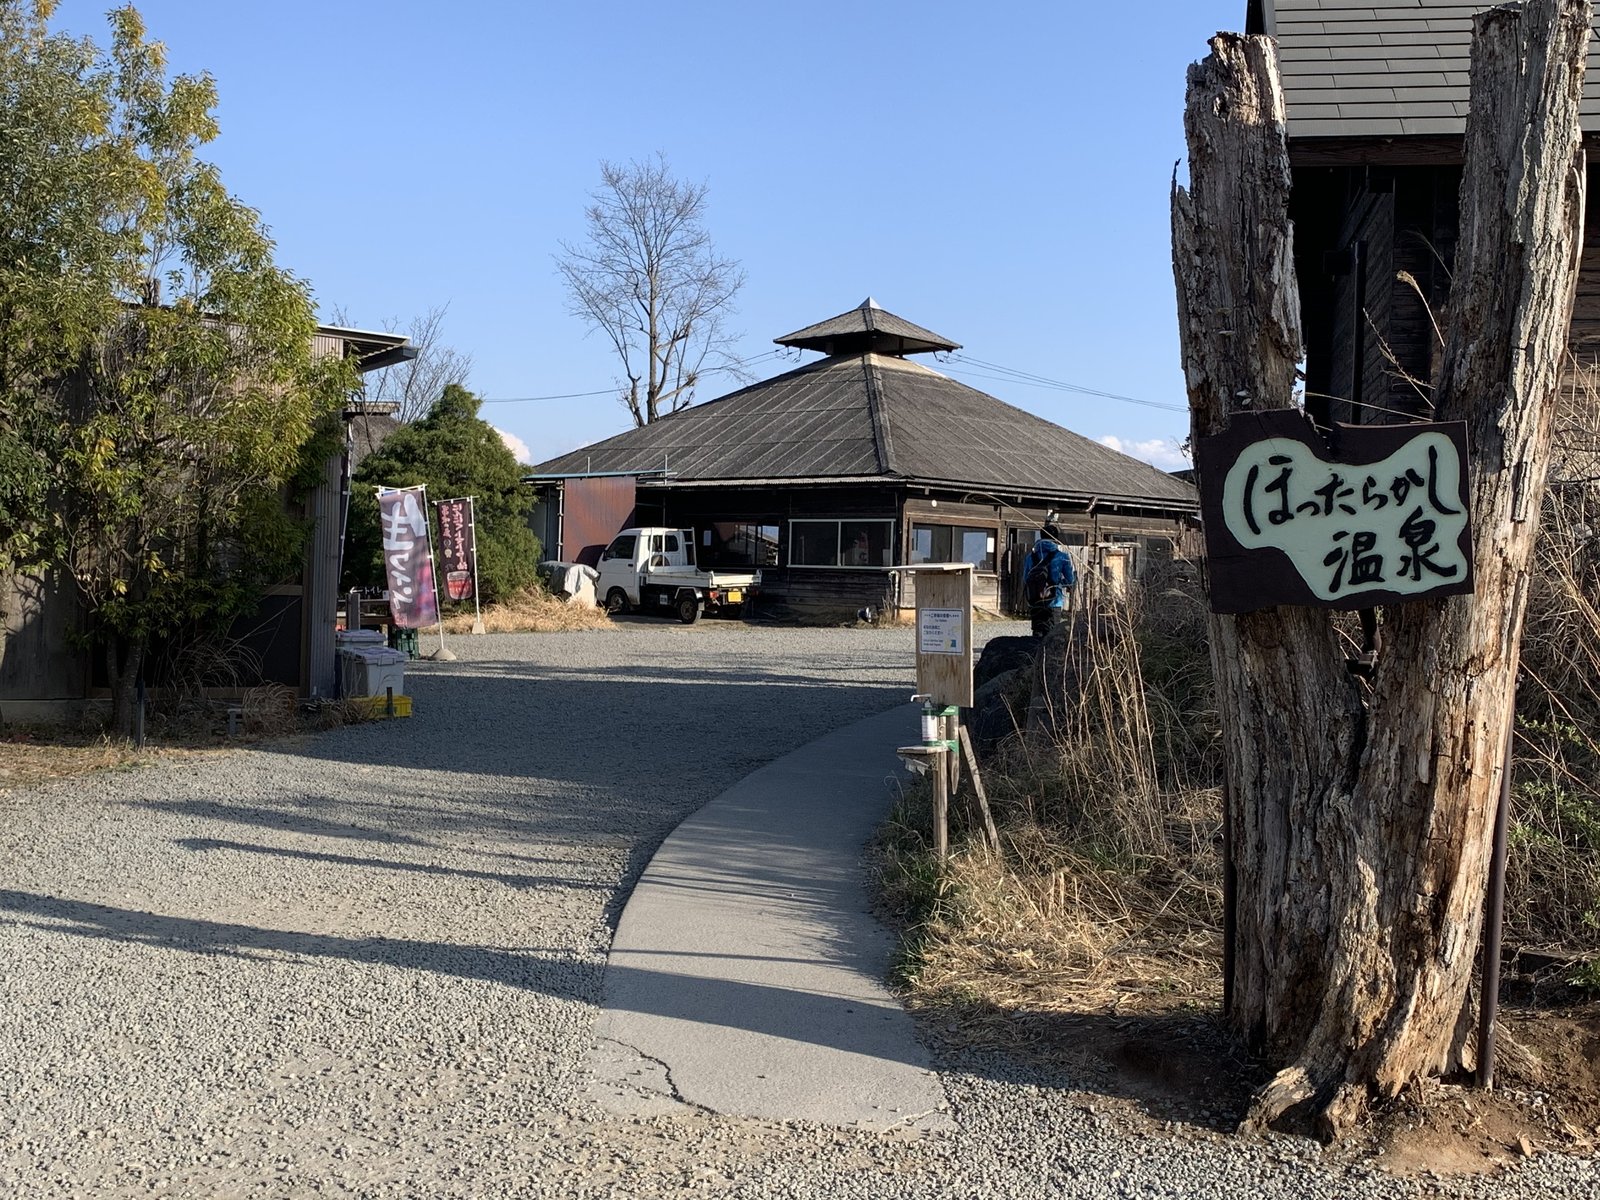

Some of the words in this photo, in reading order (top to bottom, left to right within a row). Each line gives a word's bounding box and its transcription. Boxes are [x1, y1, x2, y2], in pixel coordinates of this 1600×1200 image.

[1243, 445, 1461, 536] ほったらかし
[364, 586, 382, 595] トイレ
[1323, 505, 1458, 594] 温泉
